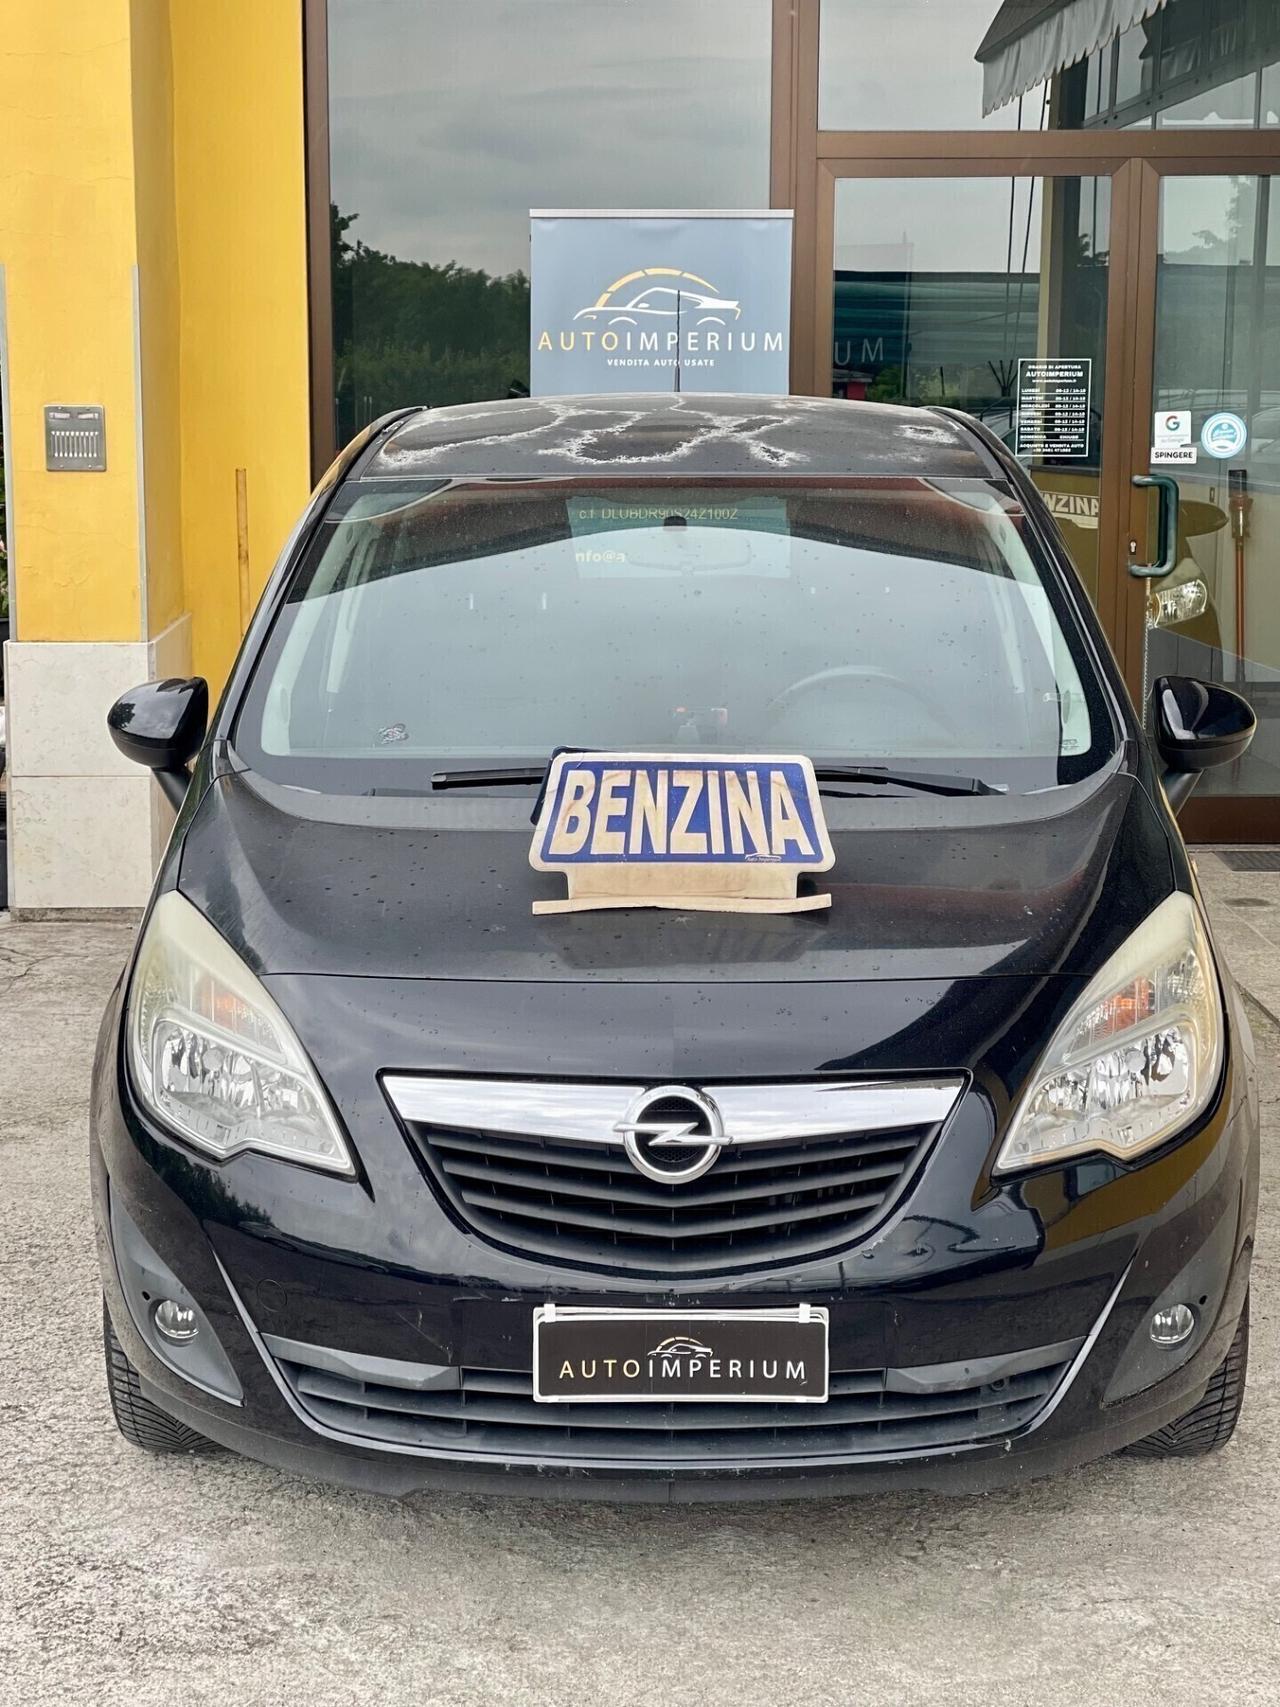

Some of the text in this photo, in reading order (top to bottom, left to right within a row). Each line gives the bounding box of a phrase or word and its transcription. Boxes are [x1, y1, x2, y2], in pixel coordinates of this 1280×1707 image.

[537, 331, 784, 352] AUTOIMPERIUM
[607, 358, 715, 367] VENDITA AUTO USATE
[1025, 370, 1084, 378] AUTOIMPERIUM
[1154, 451, 1193, 459] SPINGERE
[1040, 492, 1099, 516] NZINA
[548, 769, 815, 856] BENZINA
[559, 1358, 807, 1380] AUTOIMPERIUM
